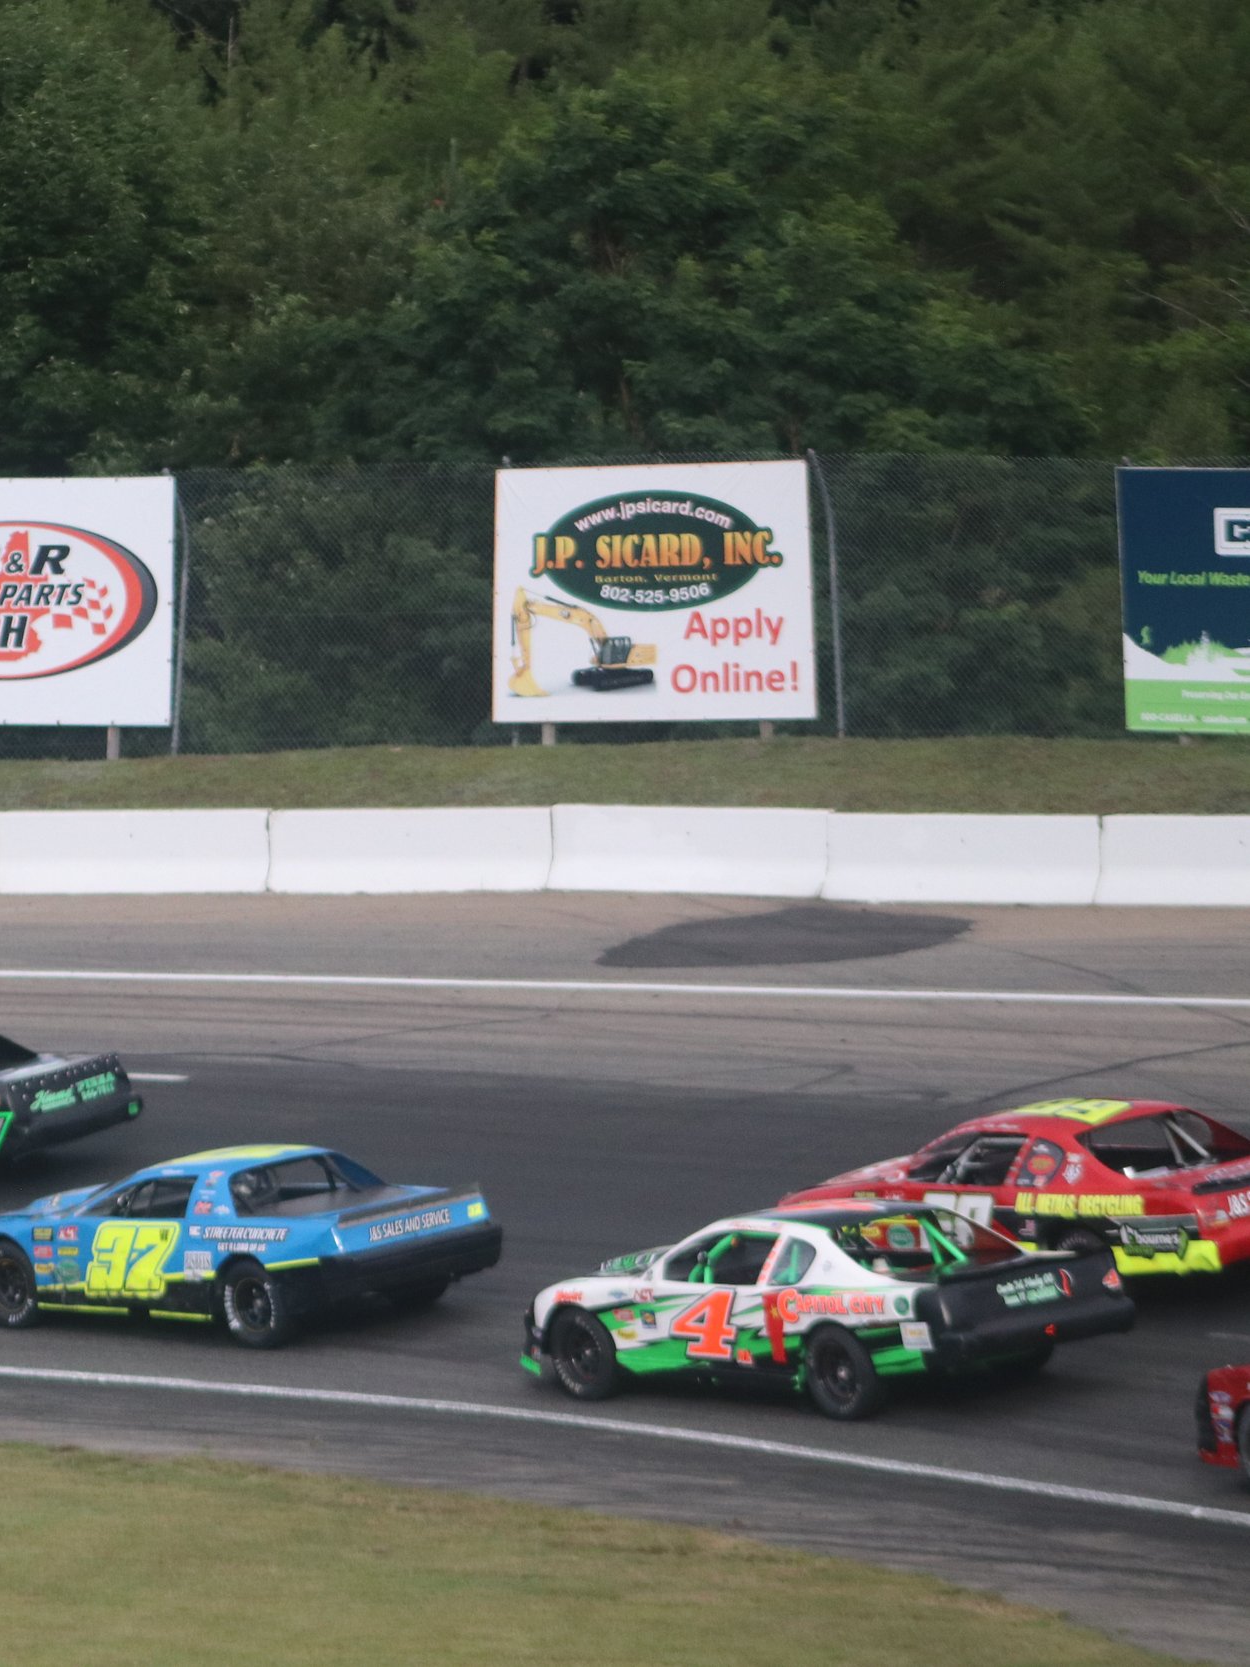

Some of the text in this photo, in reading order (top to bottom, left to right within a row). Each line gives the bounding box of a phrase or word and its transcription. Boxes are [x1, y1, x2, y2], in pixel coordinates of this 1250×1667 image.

[574, 498, 734, 533] www.jpsicard.com
[533, 530, 783, 574] J.P. SICARD, INC.
[600, 583, 711, 604] 802-525-9506
[654, 572, 719, 583] Vermont
[1137, 570, 1250, 586] Your Local Waste
[684, 608, 784, 646] Apply
[671, 662, 799, 694] Online!
[369, 1225, 382, 1240] J&S
[382, 1219, 404, 1238] SALES
[405, 1215, 421, 1232] AND
[421, 1208, 450, 1229] SERVICE
[85, 1221, 180, 1298] 37
[777, 1288, 885, 1323] CAPITOL CITY
[669, 1287, 737, 1360] 4
